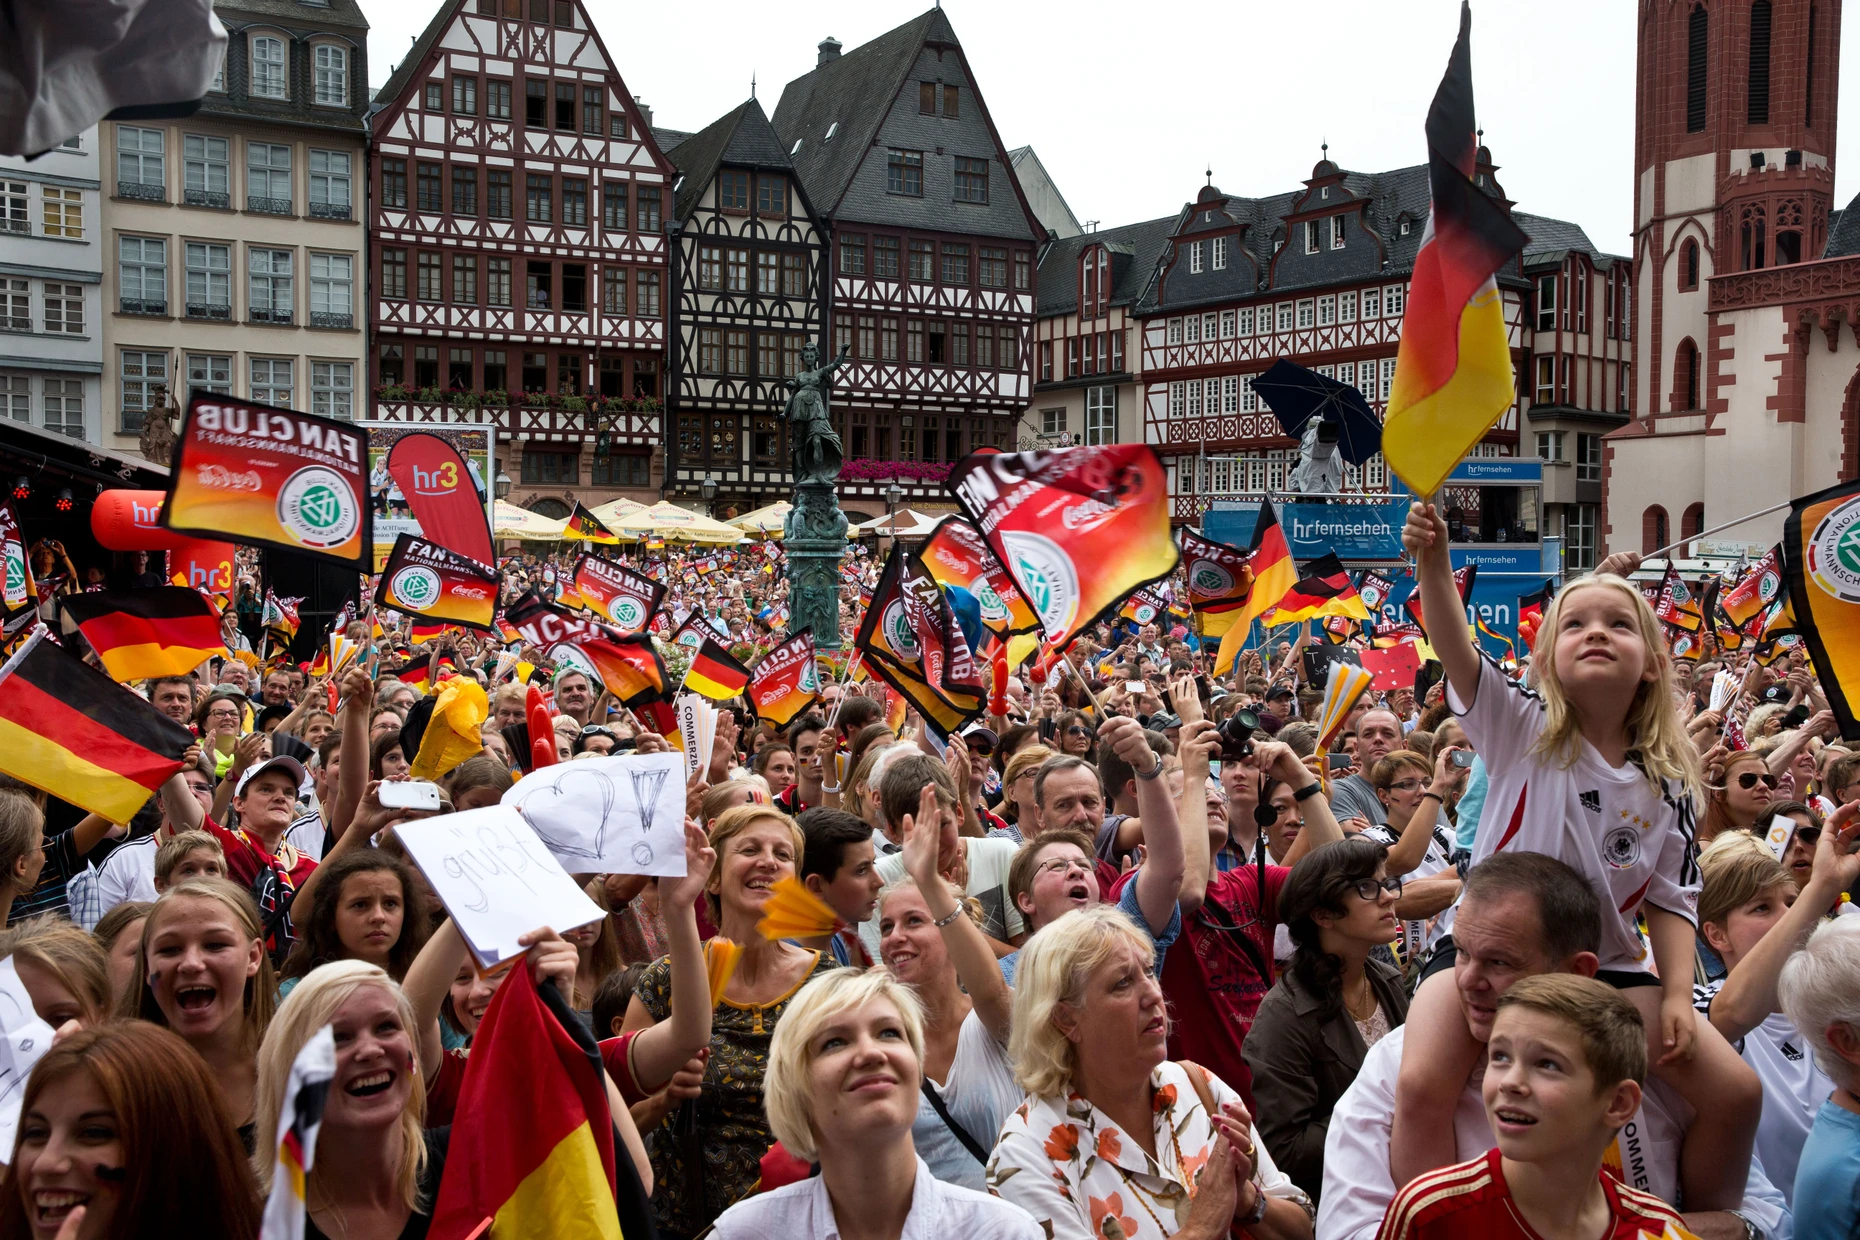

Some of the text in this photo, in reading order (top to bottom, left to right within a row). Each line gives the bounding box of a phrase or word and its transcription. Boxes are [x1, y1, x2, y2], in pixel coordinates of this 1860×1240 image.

[413, 462, 458, 488] hr3
[132, 500, 165, 523] hr
[406, 540, 447, 564] FAN
[1184, 537, 1224, 560] FAN
[190, 561, 232, 588] hr3
[692, 618, 710, 639] FAN
[684, 706, 698, 773] COMMERZBA
